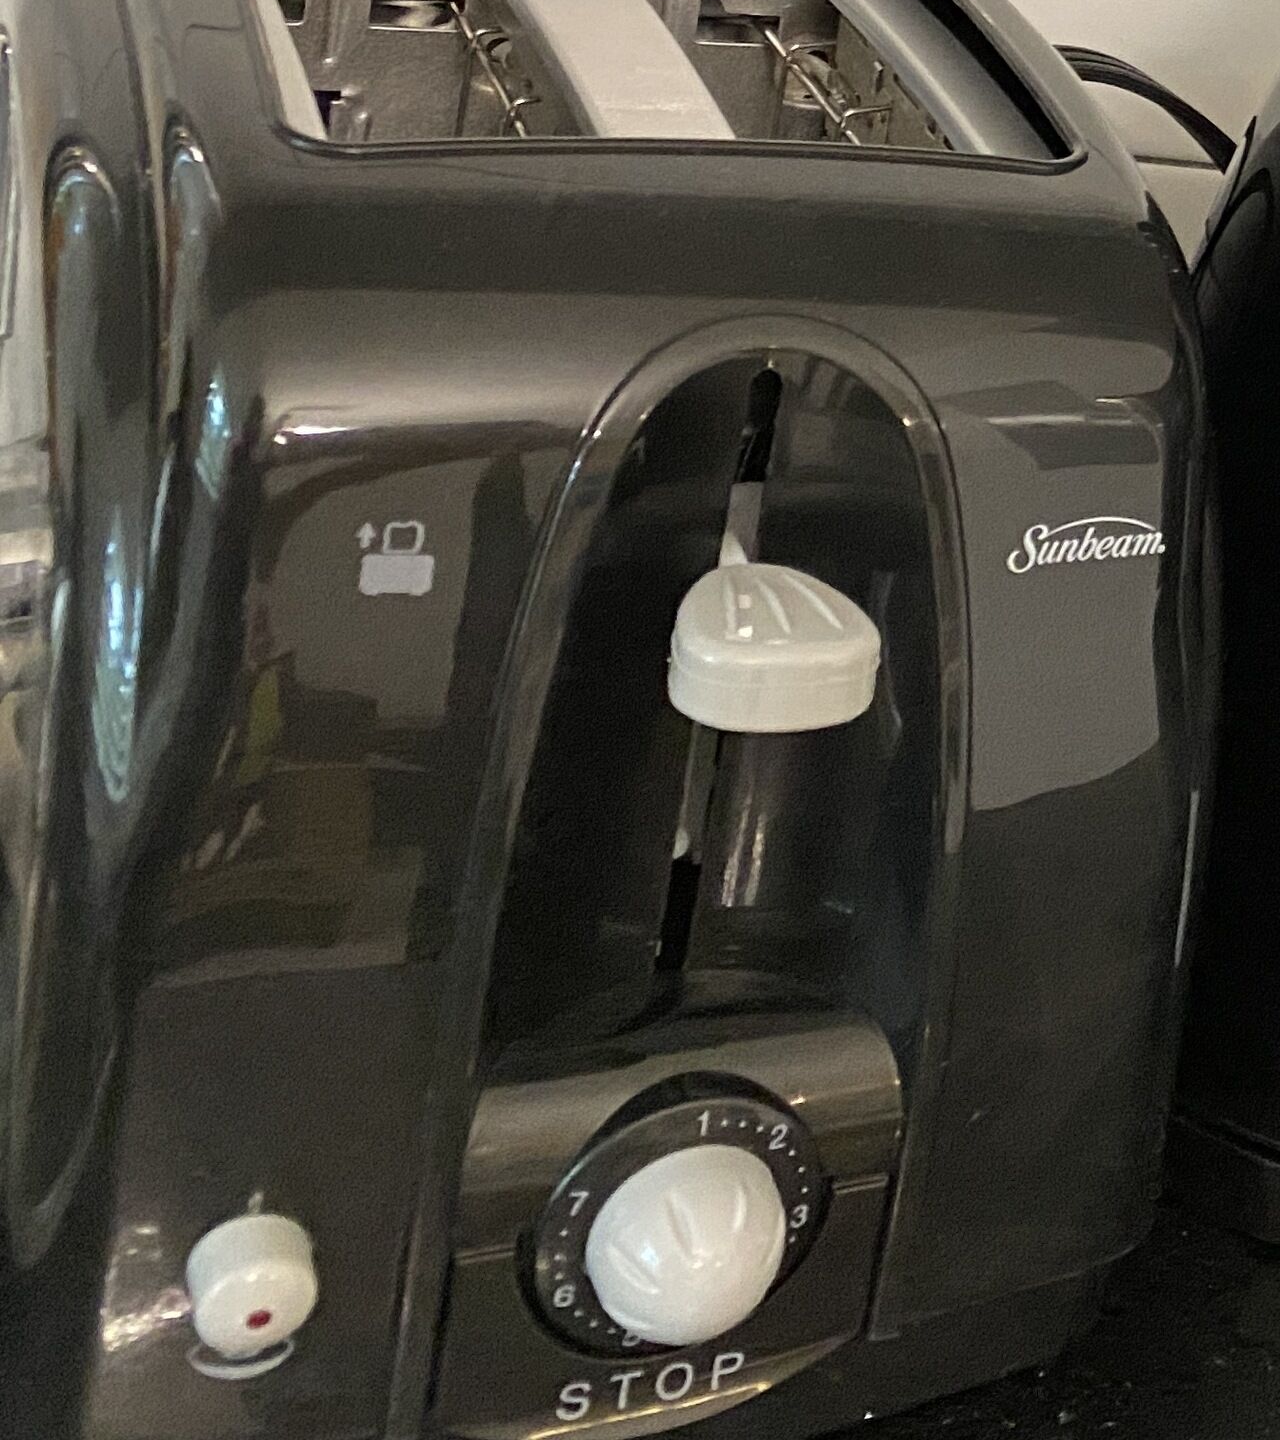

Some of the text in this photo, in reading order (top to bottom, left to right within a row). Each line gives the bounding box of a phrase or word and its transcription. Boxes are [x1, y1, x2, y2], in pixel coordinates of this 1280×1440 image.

[1006, 516, 1164, 574] Sunbeam
[697, 1111, 710, 1136] 1
[769, 1123, 788, 1150] 2
[568, 1191, 590, 1216] 7
[790, 1204, 808, 1228] 3
[553, 1285, 577, 1308] 6
[555, 1351, 745, 1422] STOP
